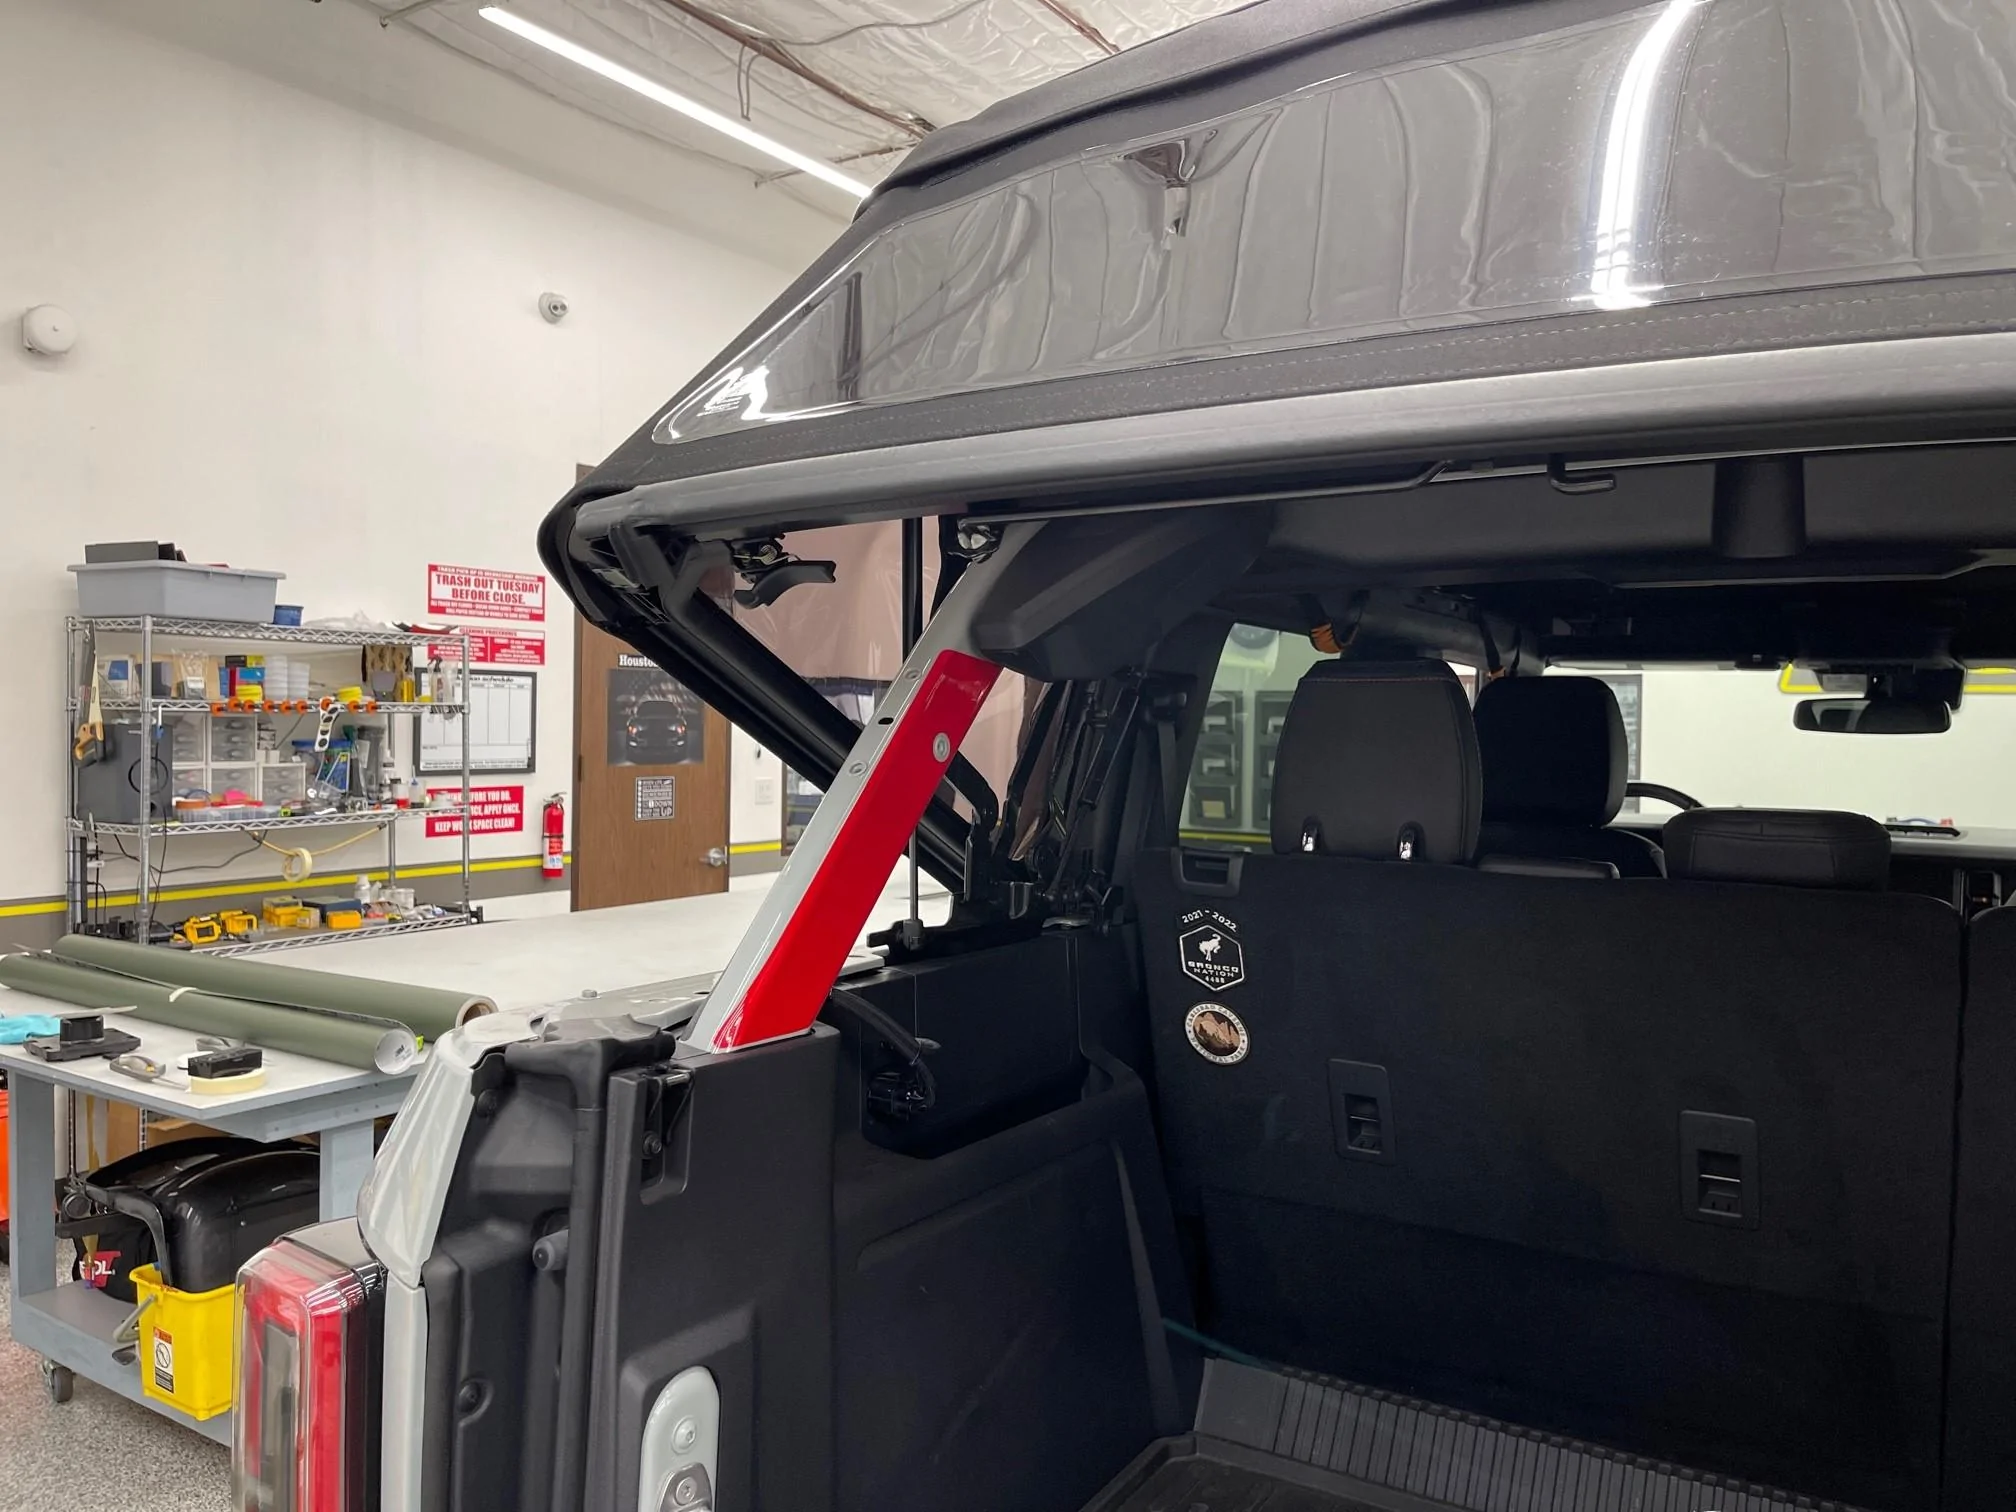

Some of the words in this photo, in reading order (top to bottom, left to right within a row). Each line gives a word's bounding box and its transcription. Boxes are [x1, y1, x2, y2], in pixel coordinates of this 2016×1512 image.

[435, 574, 471, 587] TRASH
[474, 577, 494, 590] OUT
[497, 579, 540, 594] TUESDAY
[451, 587, 491, 602] BEFORE
[492, 591, 526, 605] CLOSE.
[484, 803, 503, 815] APPLY
[434, 821, 451, 833] KEEP
[473, 818, 494, 830] SPACE
[494, 817, 515, 829] CLEAN!
[1182, 909, 1203, 923] 2021
[1212, 911, 1237, 933] 2022
[1187, 960, 1239, 973] BRONCO
[1193, 967, 1234, 978] NATION
